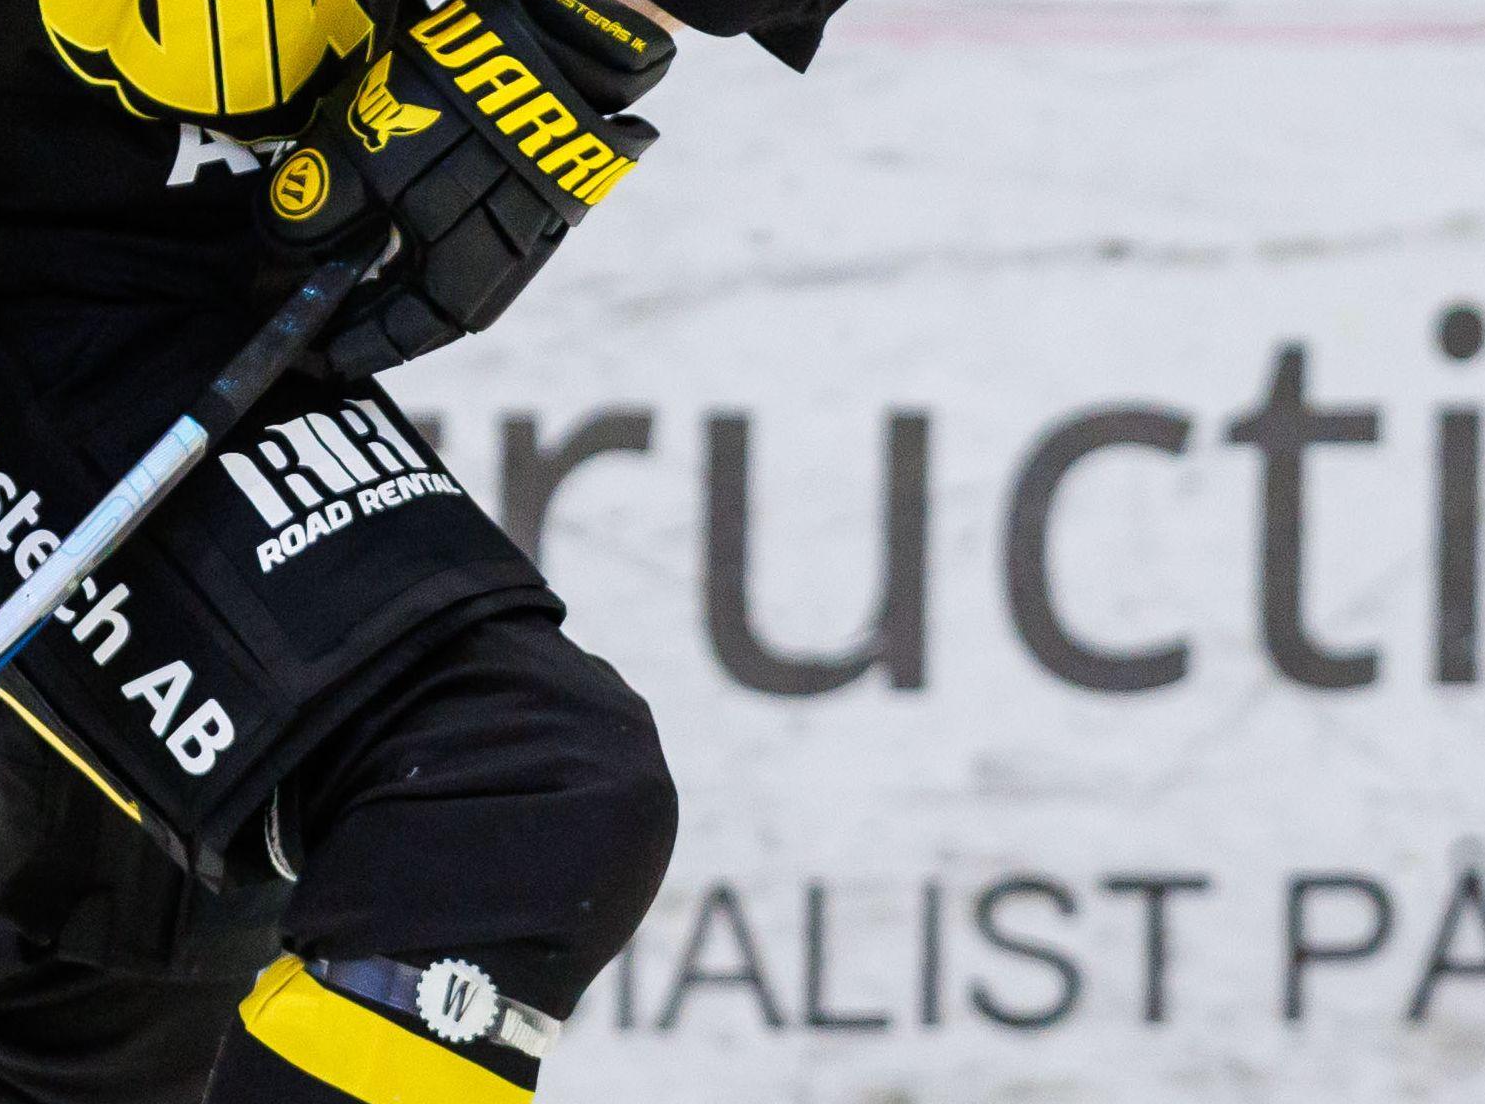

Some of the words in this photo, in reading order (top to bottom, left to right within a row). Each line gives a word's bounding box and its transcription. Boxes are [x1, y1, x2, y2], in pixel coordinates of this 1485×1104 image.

[256, 500, 353, 574] ROAD
[356, 472, 462, 516] RENTAL
[120, 658, 236, 777] AB
